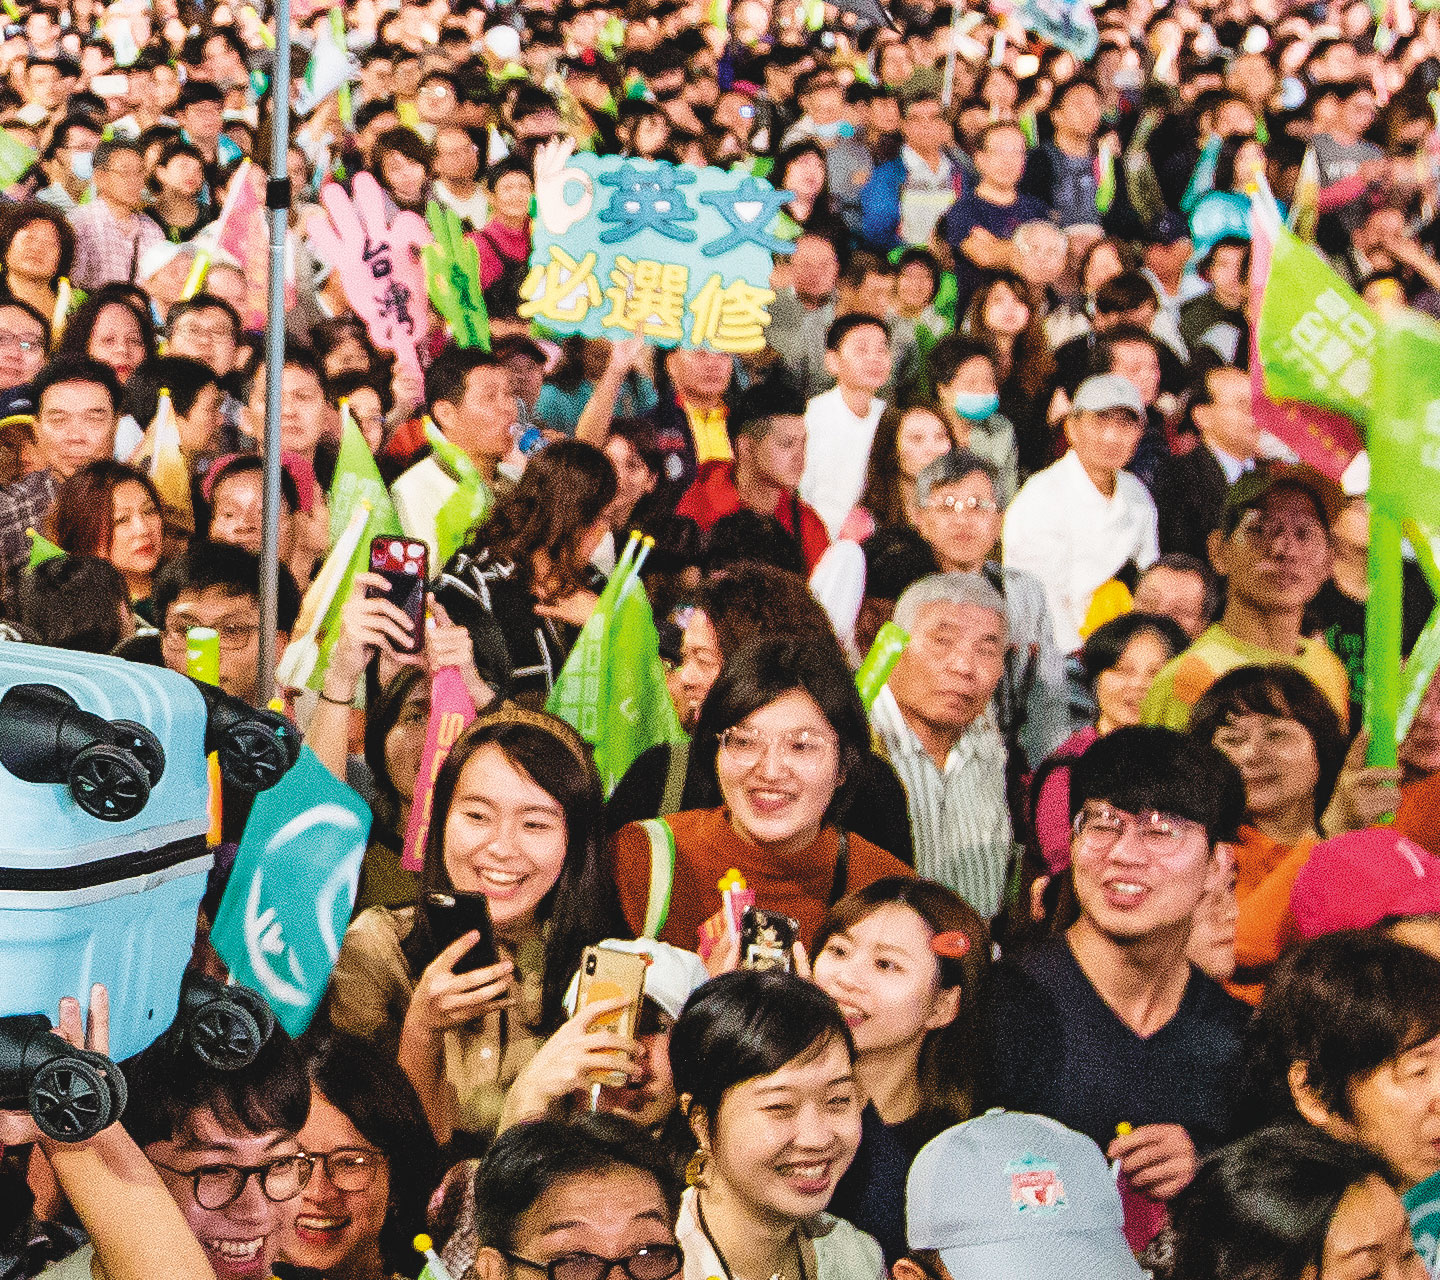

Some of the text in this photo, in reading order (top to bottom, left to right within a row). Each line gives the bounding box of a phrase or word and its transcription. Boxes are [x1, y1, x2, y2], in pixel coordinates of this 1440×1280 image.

[598, 161, 798, 258] 英文
[517, 244, 777, 353] 必選修
